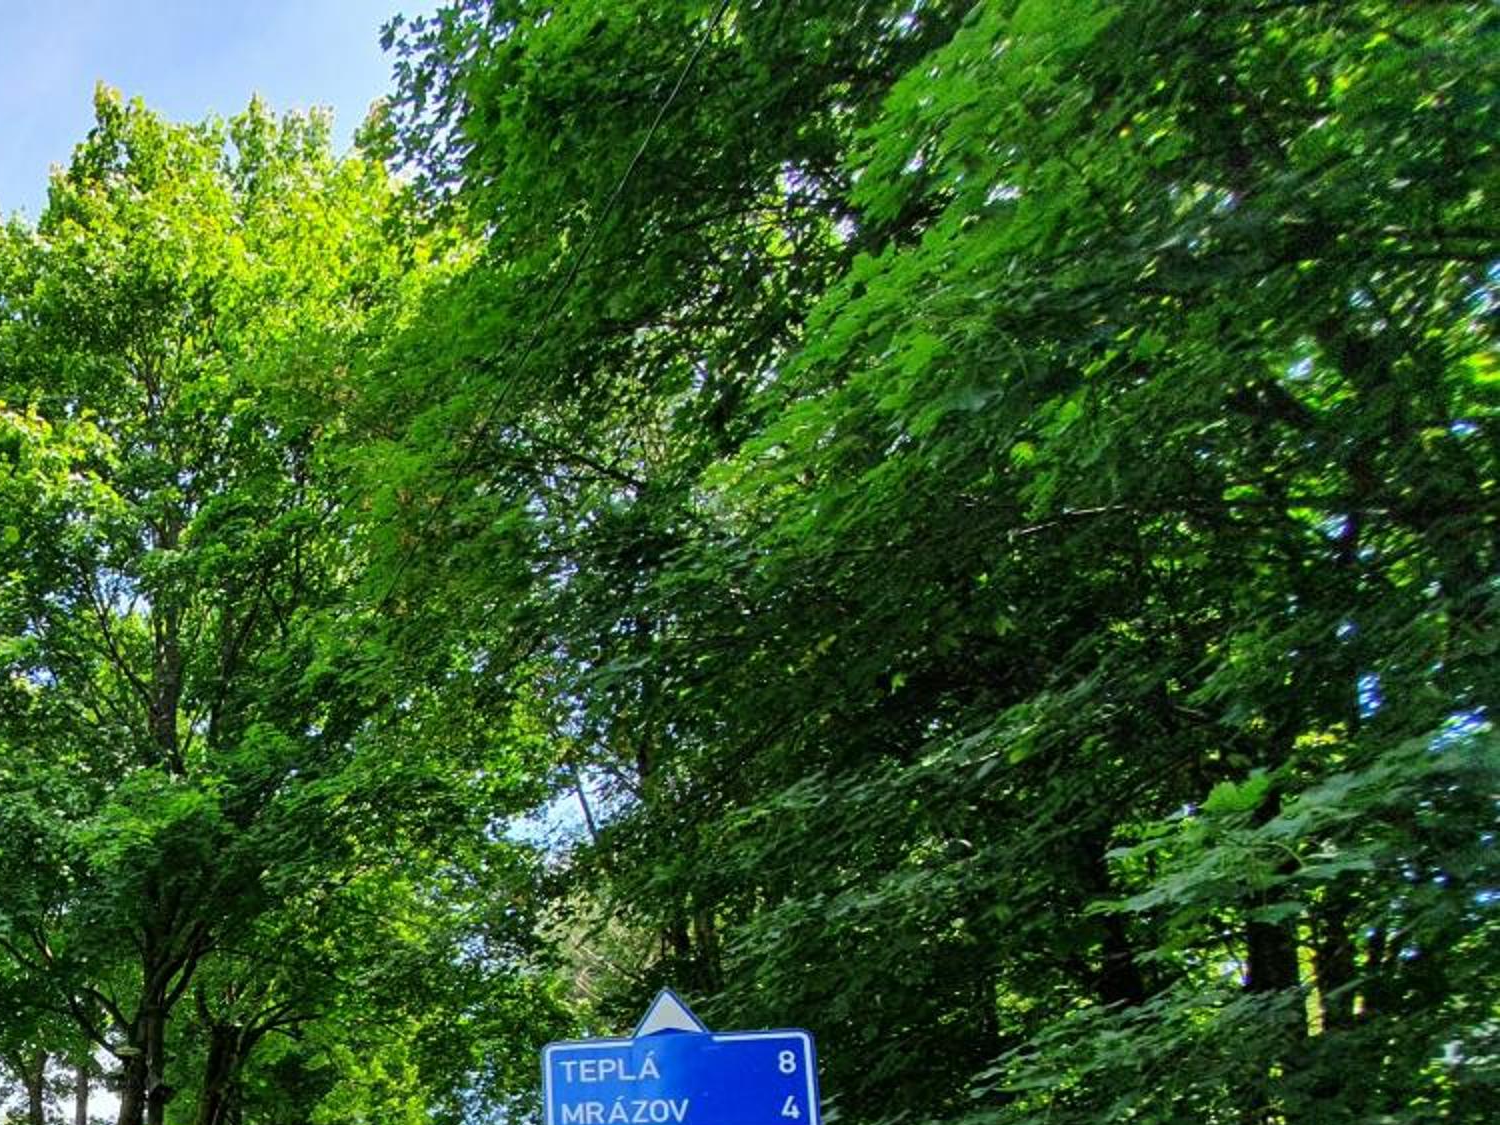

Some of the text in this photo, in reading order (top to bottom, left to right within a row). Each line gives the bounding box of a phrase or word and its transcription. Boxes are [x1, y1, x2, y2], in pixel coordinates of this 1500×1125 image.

[560, 1050, 797, 1083] TEPLÁ 8
[561, 1095, 800, 1125] MRÁZOV 4
